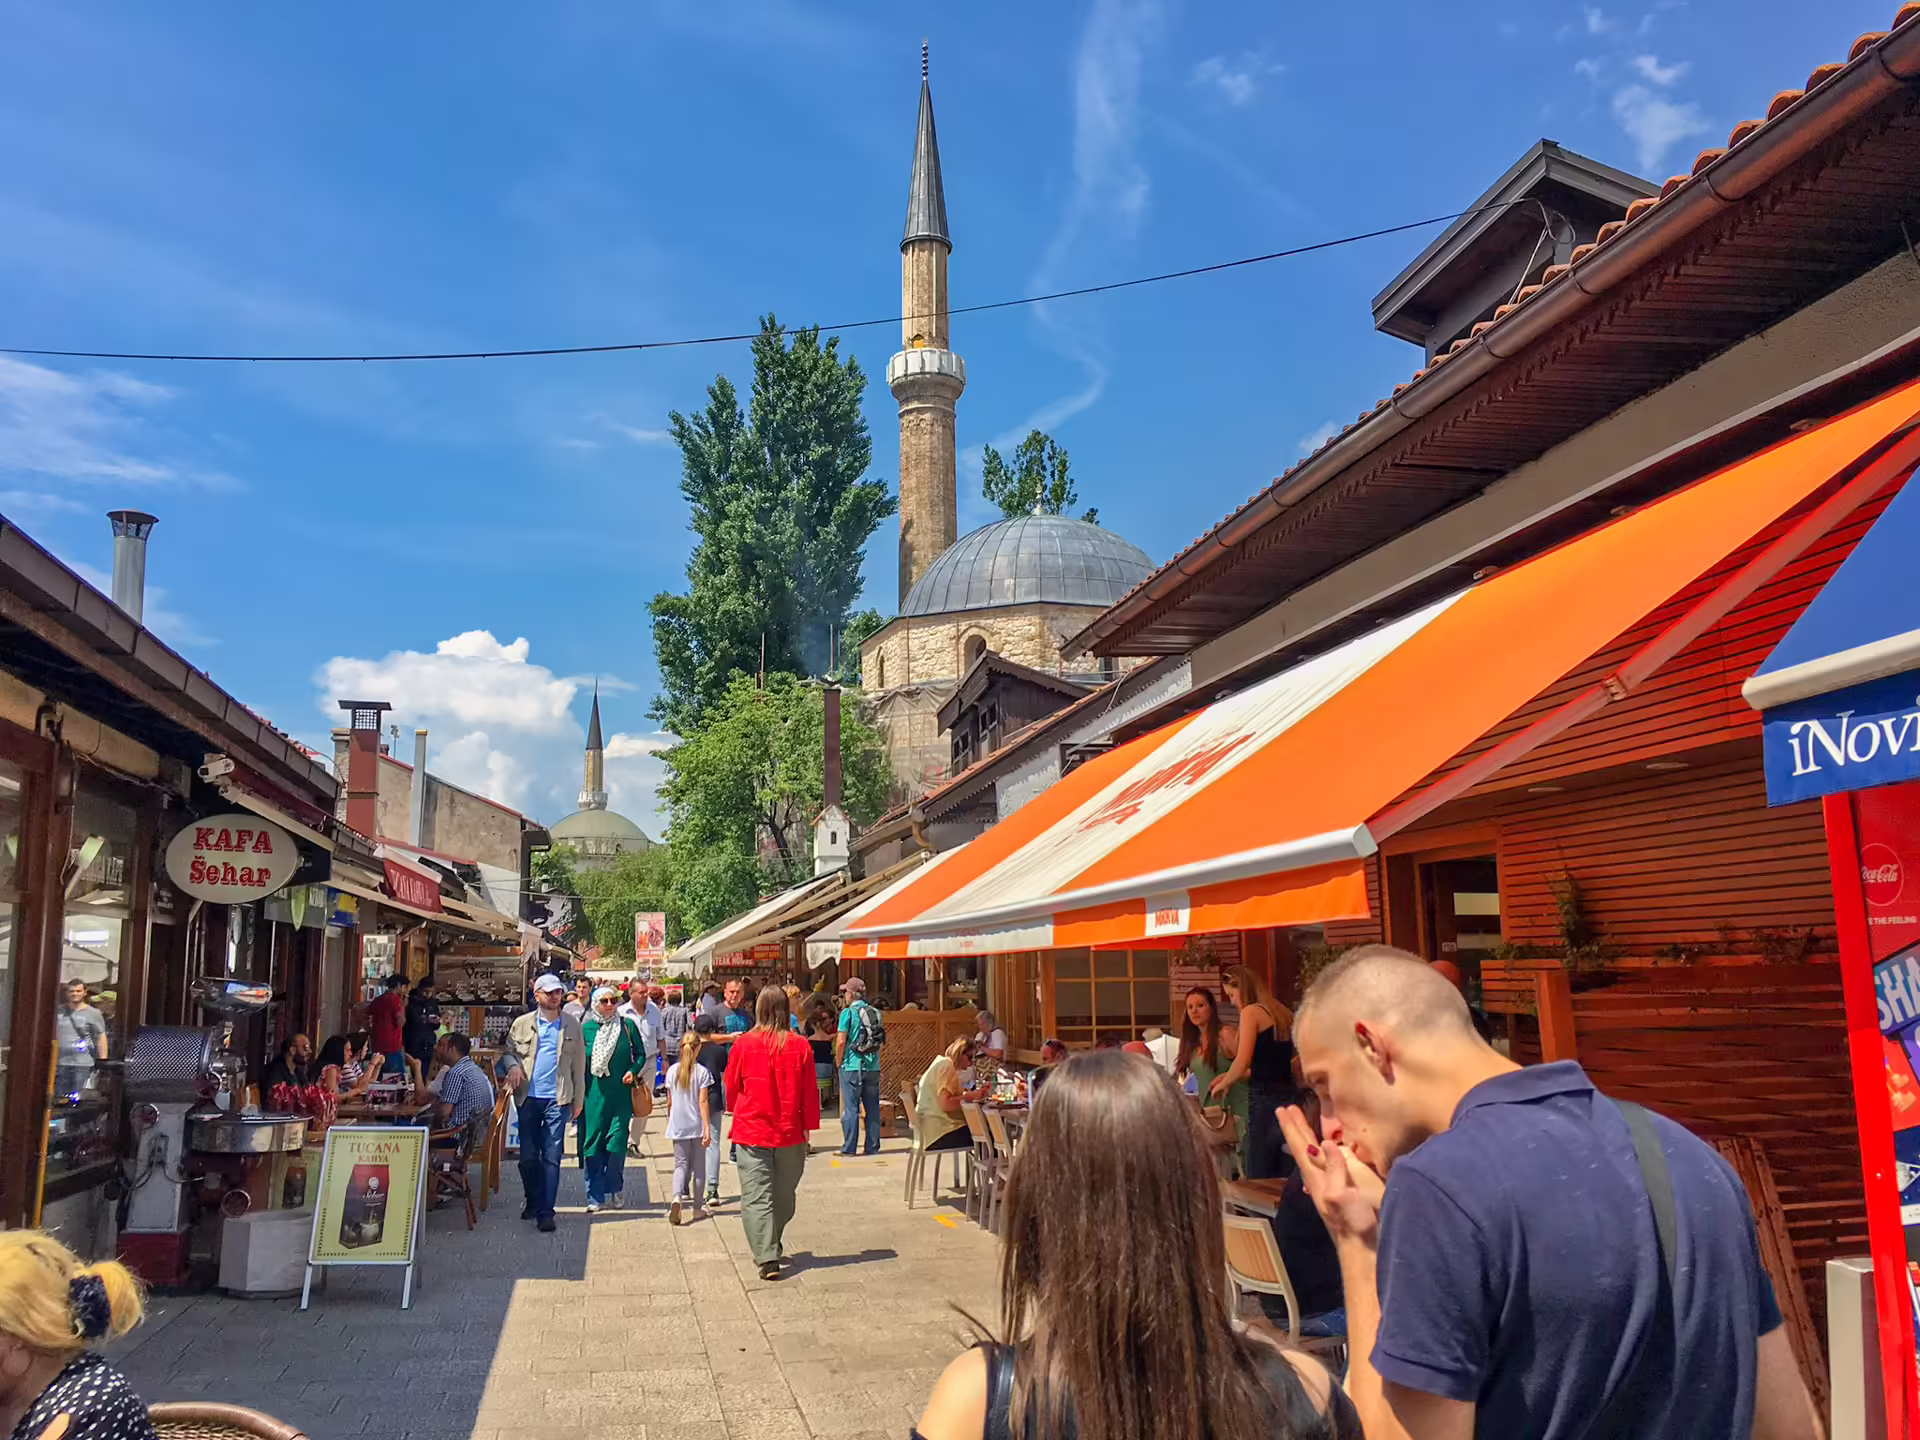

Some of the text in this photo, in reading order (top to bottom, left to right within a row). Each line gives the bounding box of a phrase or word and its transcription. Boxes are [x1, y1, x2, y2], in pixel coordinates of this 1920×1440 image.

[193, 827, 272, 854] KAFA
[190, 856, 271, 887] Šehar
[349, 1142, 400, 1154] TUCANA
[358, 1154, 388, 1163] KAHVA
